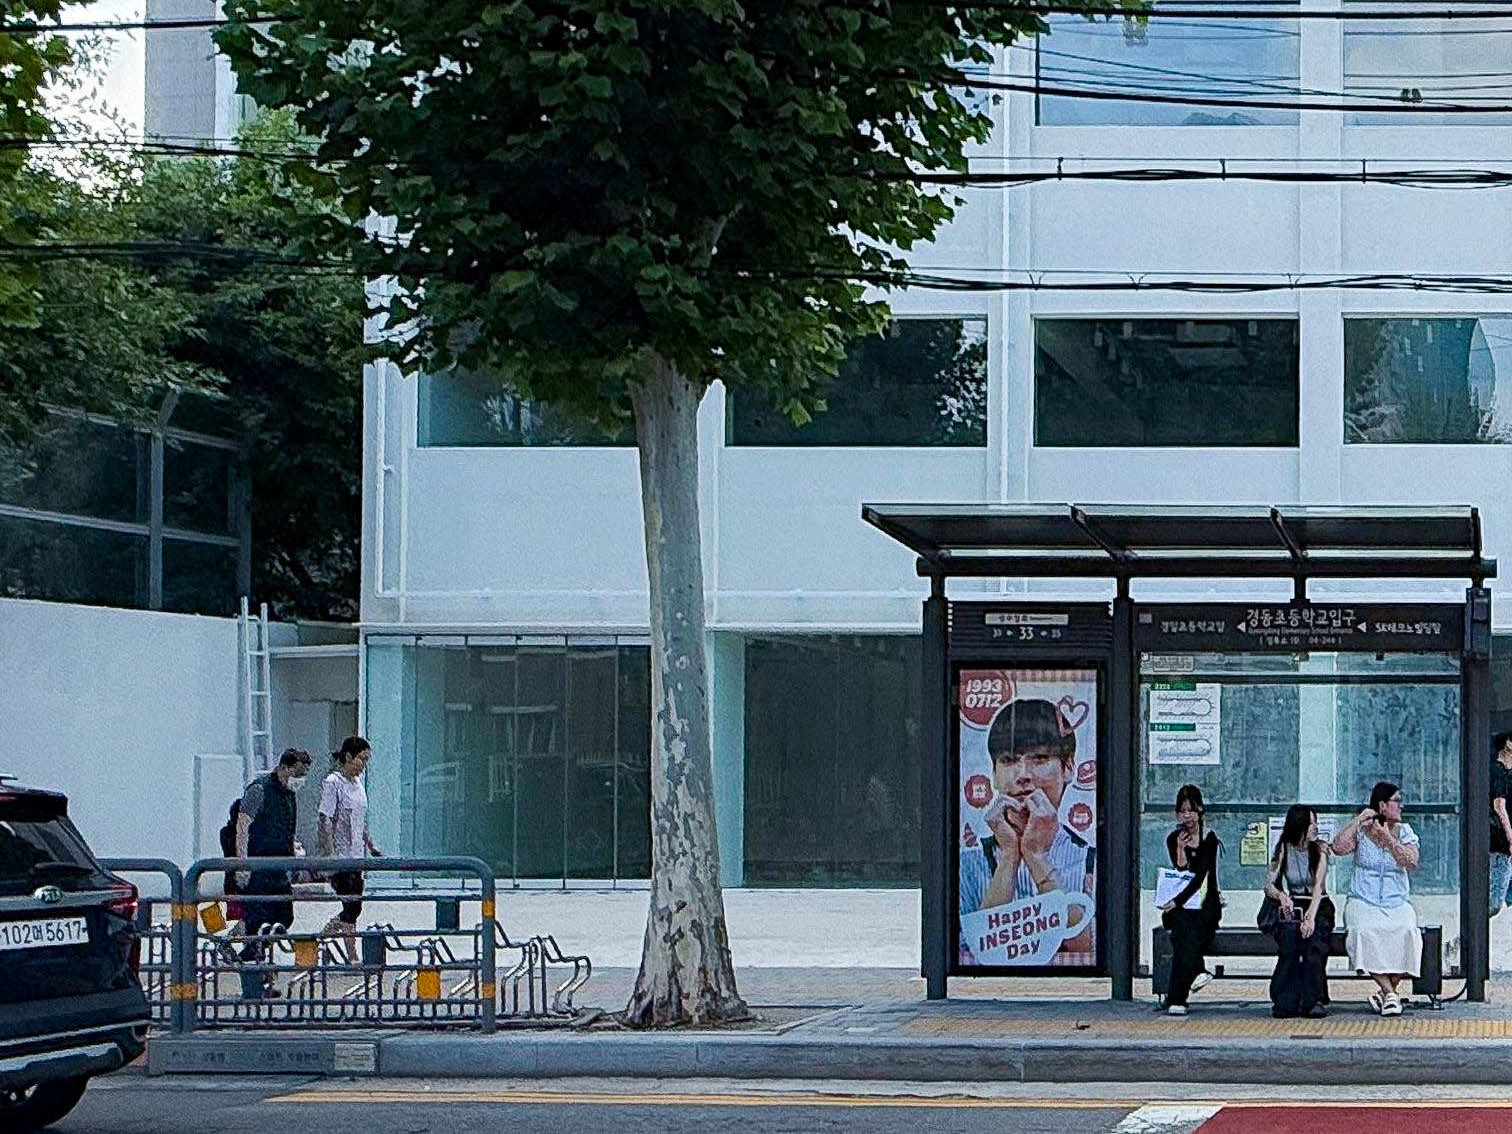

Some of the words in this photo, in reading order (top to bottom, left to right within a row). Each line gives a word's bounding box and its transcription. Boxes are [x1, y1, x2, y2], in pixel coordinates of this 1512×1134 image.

[1247, 609, 1357, 627] 경동초등학교입구
[1019, 627, 1034, 640] 33
[966, 678, 1003, 693] 1993
[965, 693, 1003, 708] 0712
[988, 902, 1042, 929] Happy
[979, 912, 1060, 952] INSEONG
[1006, 939, 1041, 960] Day
